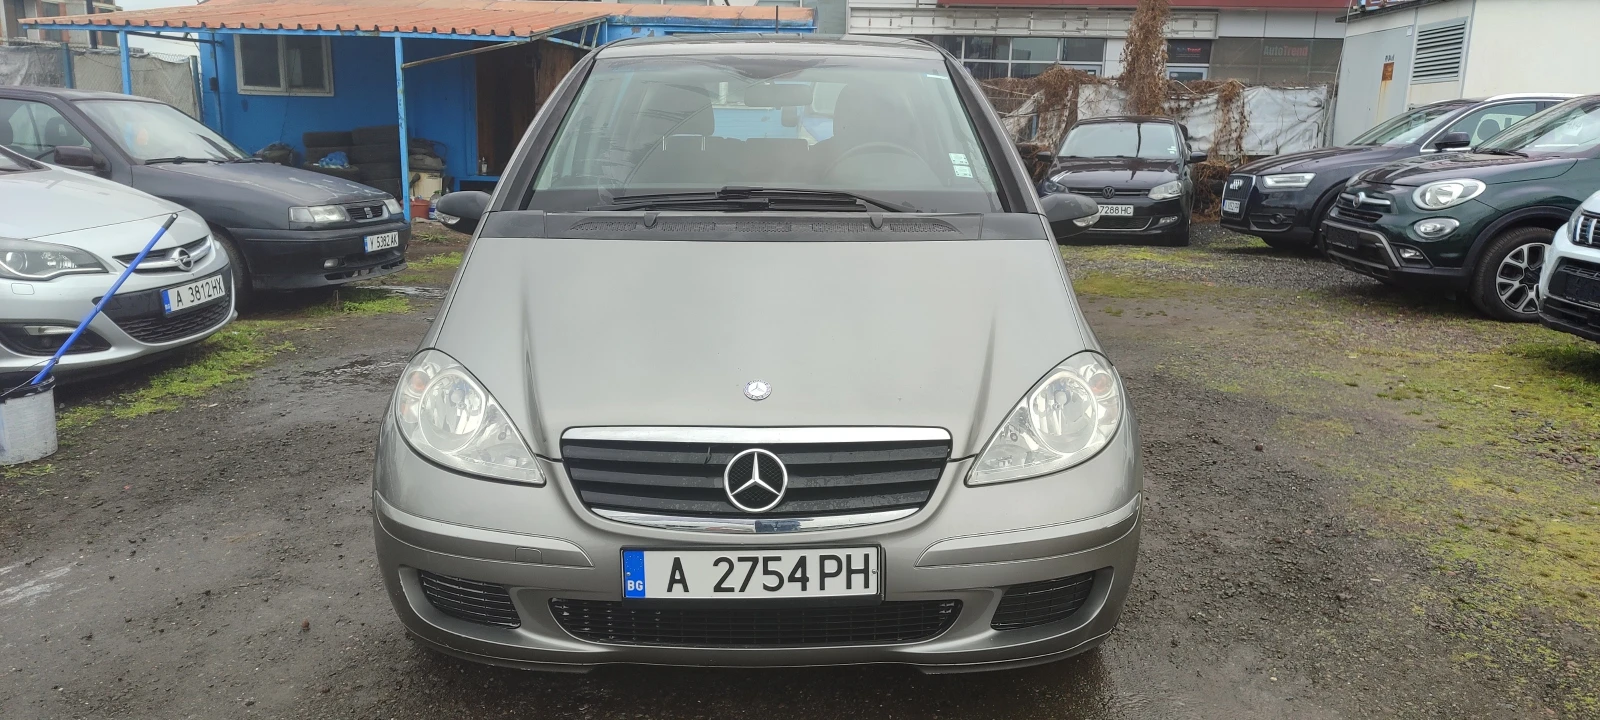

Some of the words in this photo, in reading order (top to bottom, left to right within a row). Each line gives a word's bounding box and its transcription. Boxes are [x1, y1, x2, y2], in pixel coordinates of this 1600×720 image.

[1263, 45, 1309, 57] AutoTrend
[176, 290, 184, 308] A
[666, 556, 690, 593] A
[627, 580, 644, 592] BG
